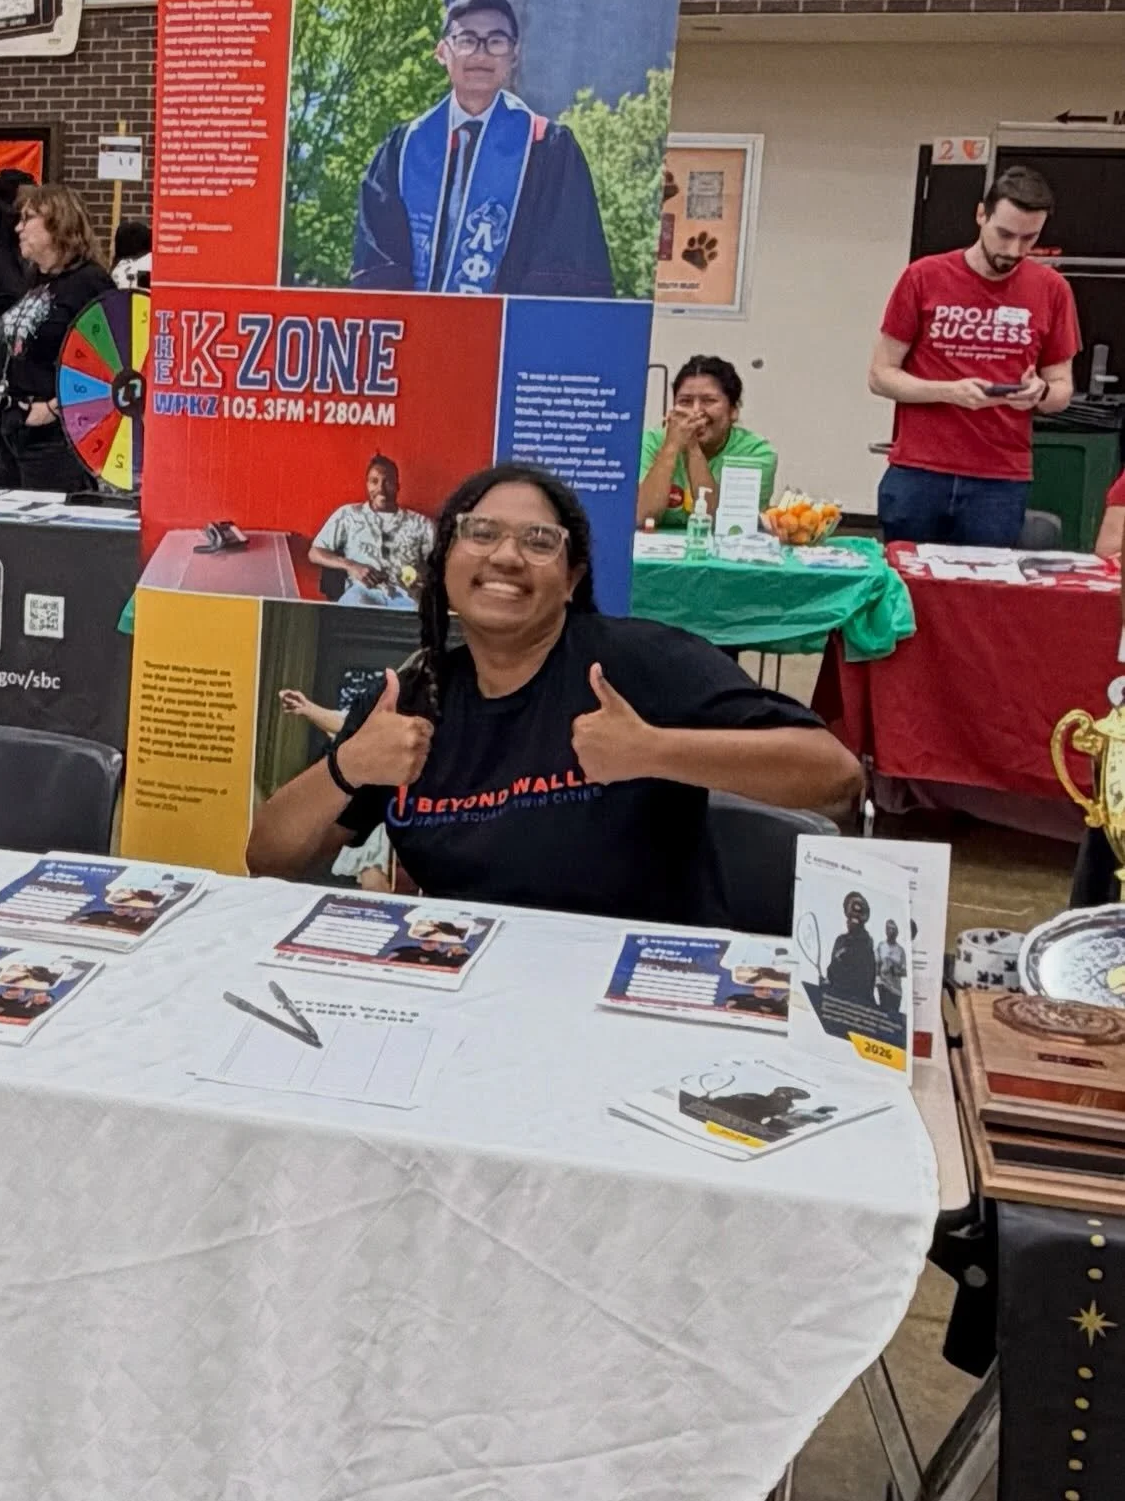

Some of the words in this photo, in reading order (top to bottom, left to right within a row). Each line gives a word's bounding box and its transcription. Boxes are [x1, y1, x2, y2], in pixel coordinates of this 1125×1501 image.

[938, 140, 955, 160] 2
[929, 322, 1033, 345] SUCCESS
[155, 311, 175, 385] THE
[179, 311, 405, 397] K-ZONE
[154, 392, 218, 418] WPKZ
[417, 788, 510, 813] BEYOND
[512, 770, 585, 795] WALL
[864, 1043, 894, 1061] 2026
